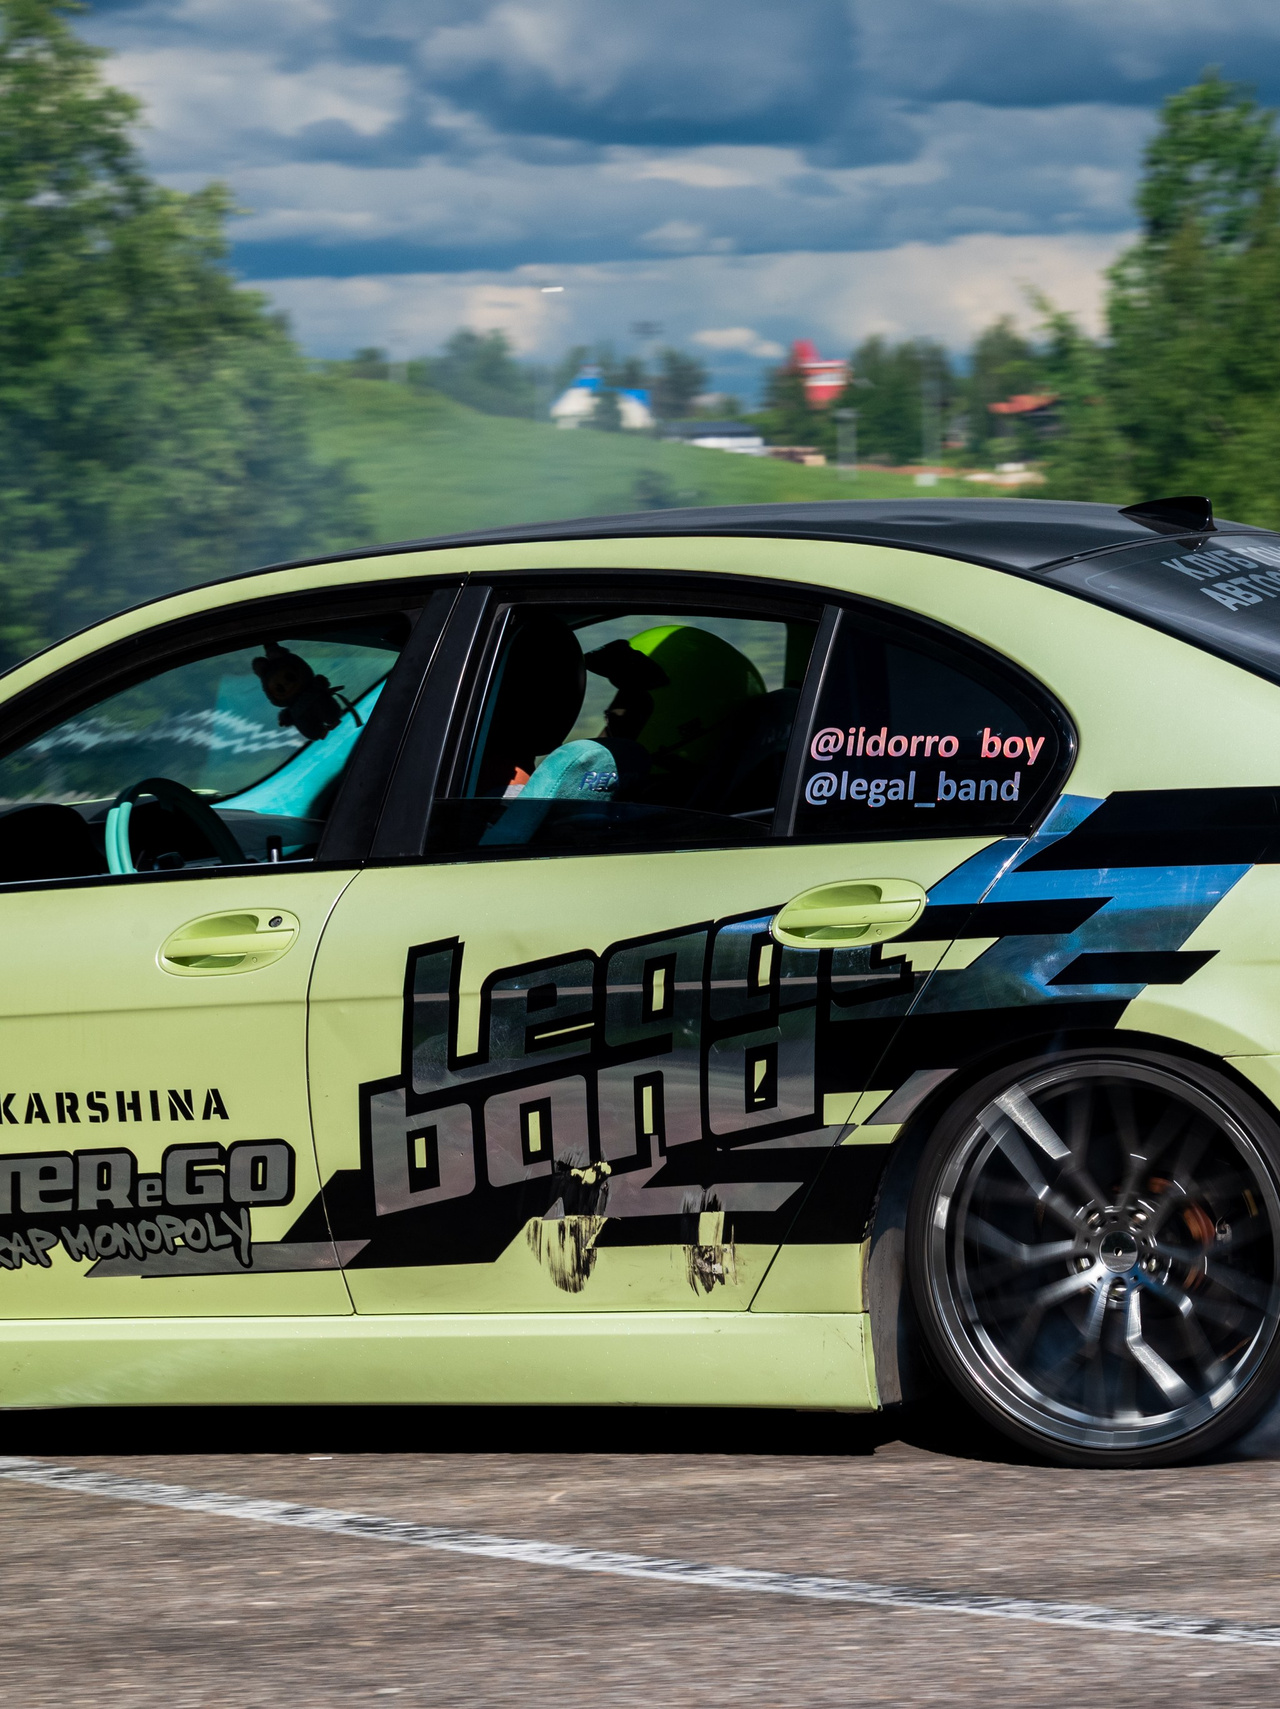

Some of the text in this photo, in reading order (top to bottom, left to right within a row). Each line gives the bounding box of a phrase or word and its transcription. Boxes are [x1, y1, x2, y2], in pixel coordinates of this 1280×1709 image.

[1160, 549, 1259, 581] КЛУБ
[980, 727, 1046, 766] boy
[804, 770, 1021, 808] @legal_band
[364, 1004, 818, 1217] band
[60, 1206, 251, 1266] MONOPOLY
